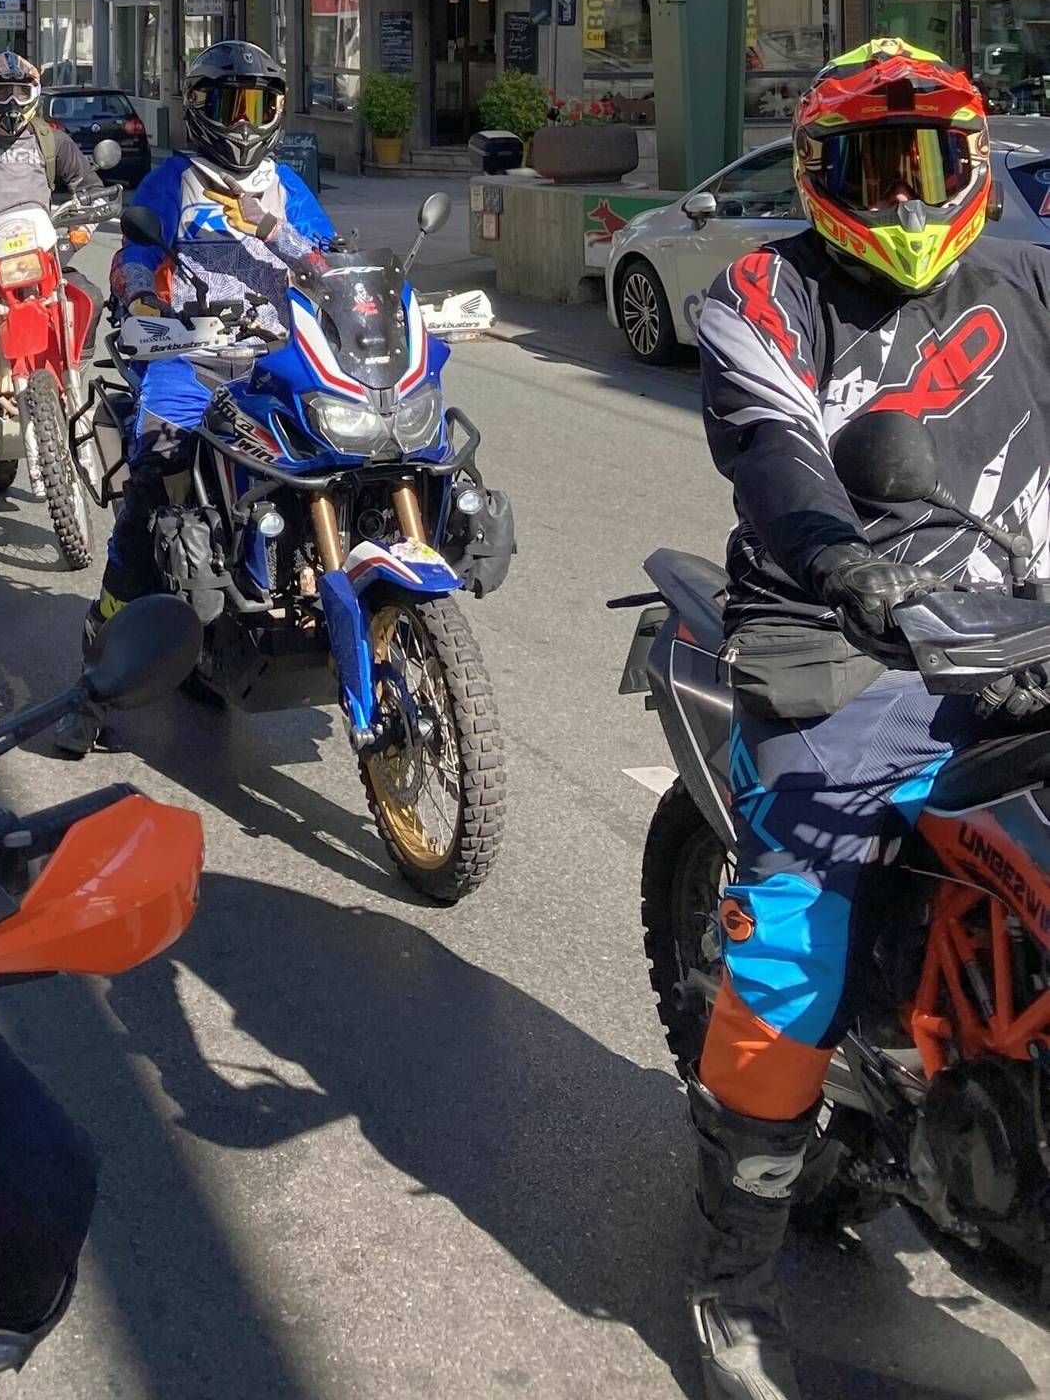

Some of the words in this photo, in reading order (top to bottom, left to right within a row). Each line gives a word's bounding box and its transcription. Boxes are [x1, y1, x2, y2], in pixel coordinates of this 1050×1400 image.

[427, 321, 481, 330] Barkbusters
[139, 335, 172, 344] HONDA
[150, 340, 211, 353] Barkbusters
